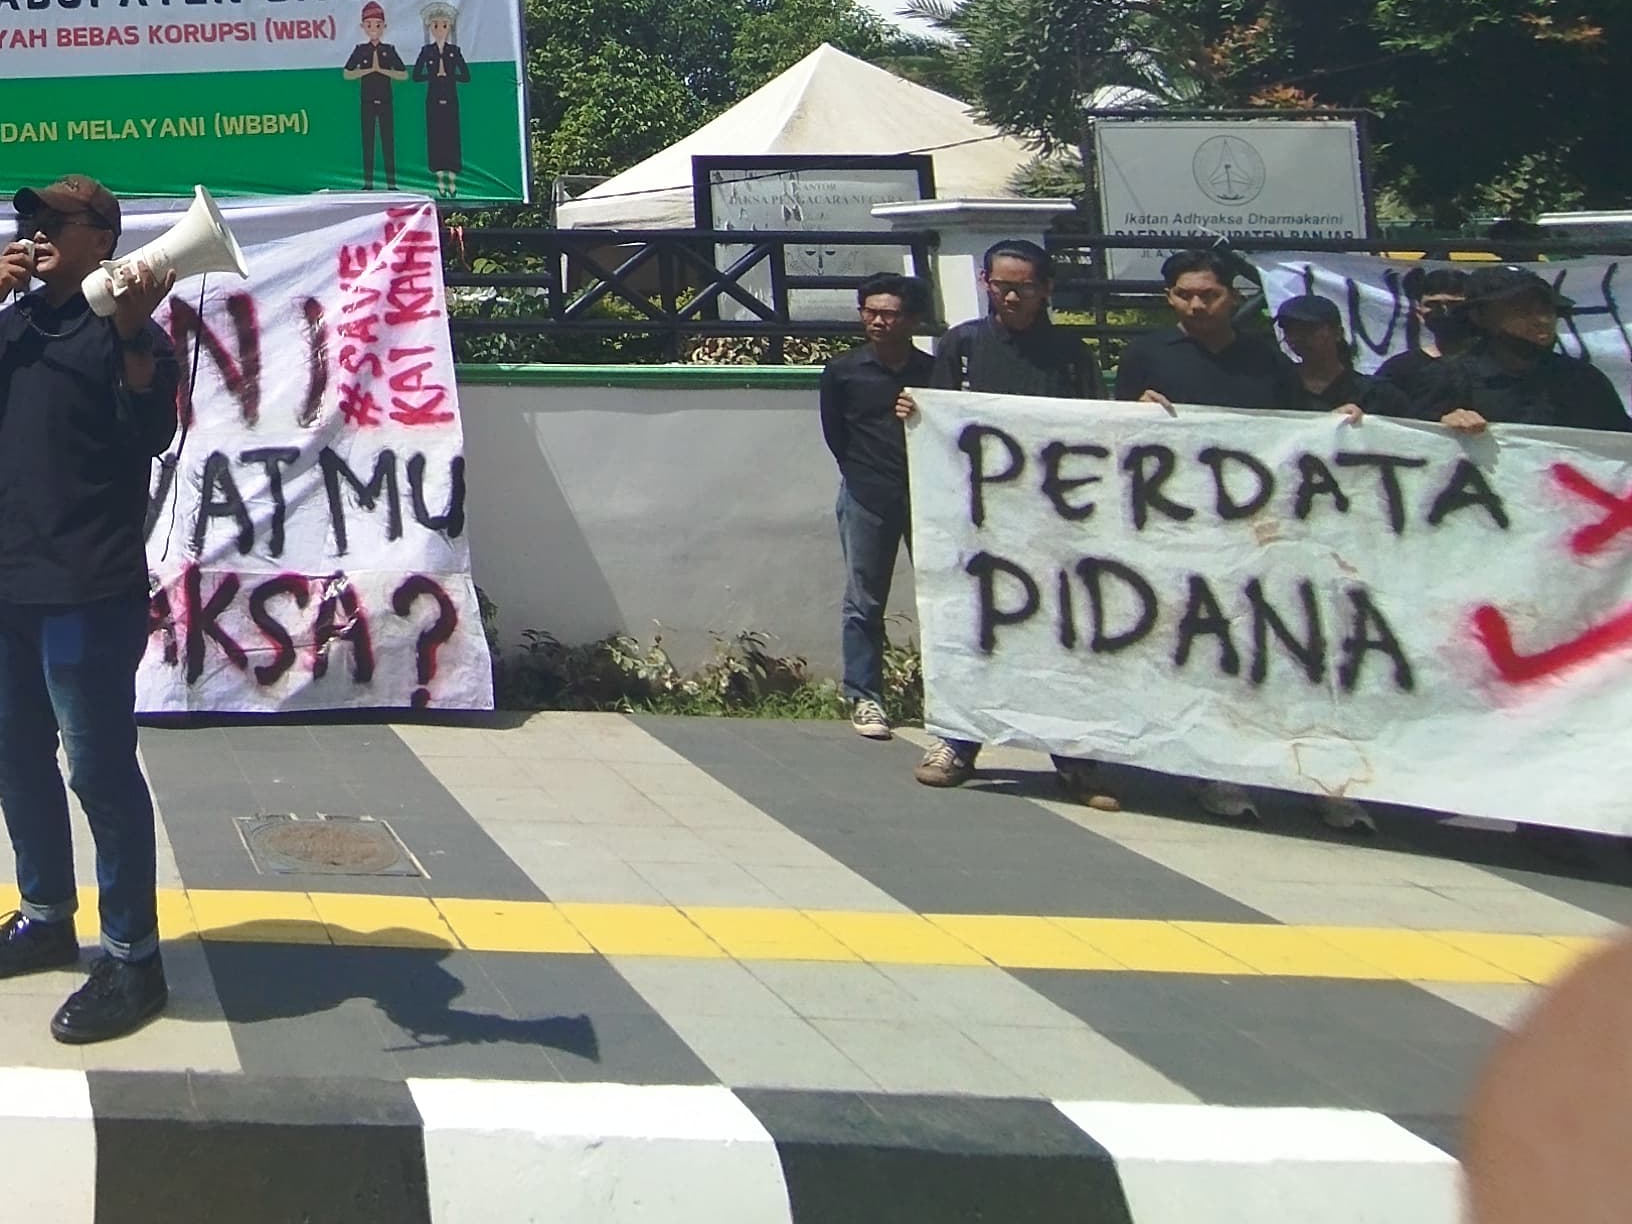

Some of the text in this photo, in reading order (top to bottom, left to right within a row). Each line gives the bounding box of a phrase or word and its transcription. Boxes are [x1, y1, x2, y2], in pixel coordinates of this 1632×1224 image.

[56, 25, 140, 48] BEBAS
[148, 21, 257, 45] KORUPSI
[264, 15, 337, 42] (WBK)
[0, 121, 58, 144] DAN
[68, 116, 205, 142] MELAYANI
[213, 108, 309, 137] (WBBM)
[1125, 213, 1344, 227] Ikatan Adhyaksa Dharmakarini
[388, 345, 455, 426] KAI
[958, 423, 1511, 536] PERDATA
[964, 550, 1415, 692] PIDANA
